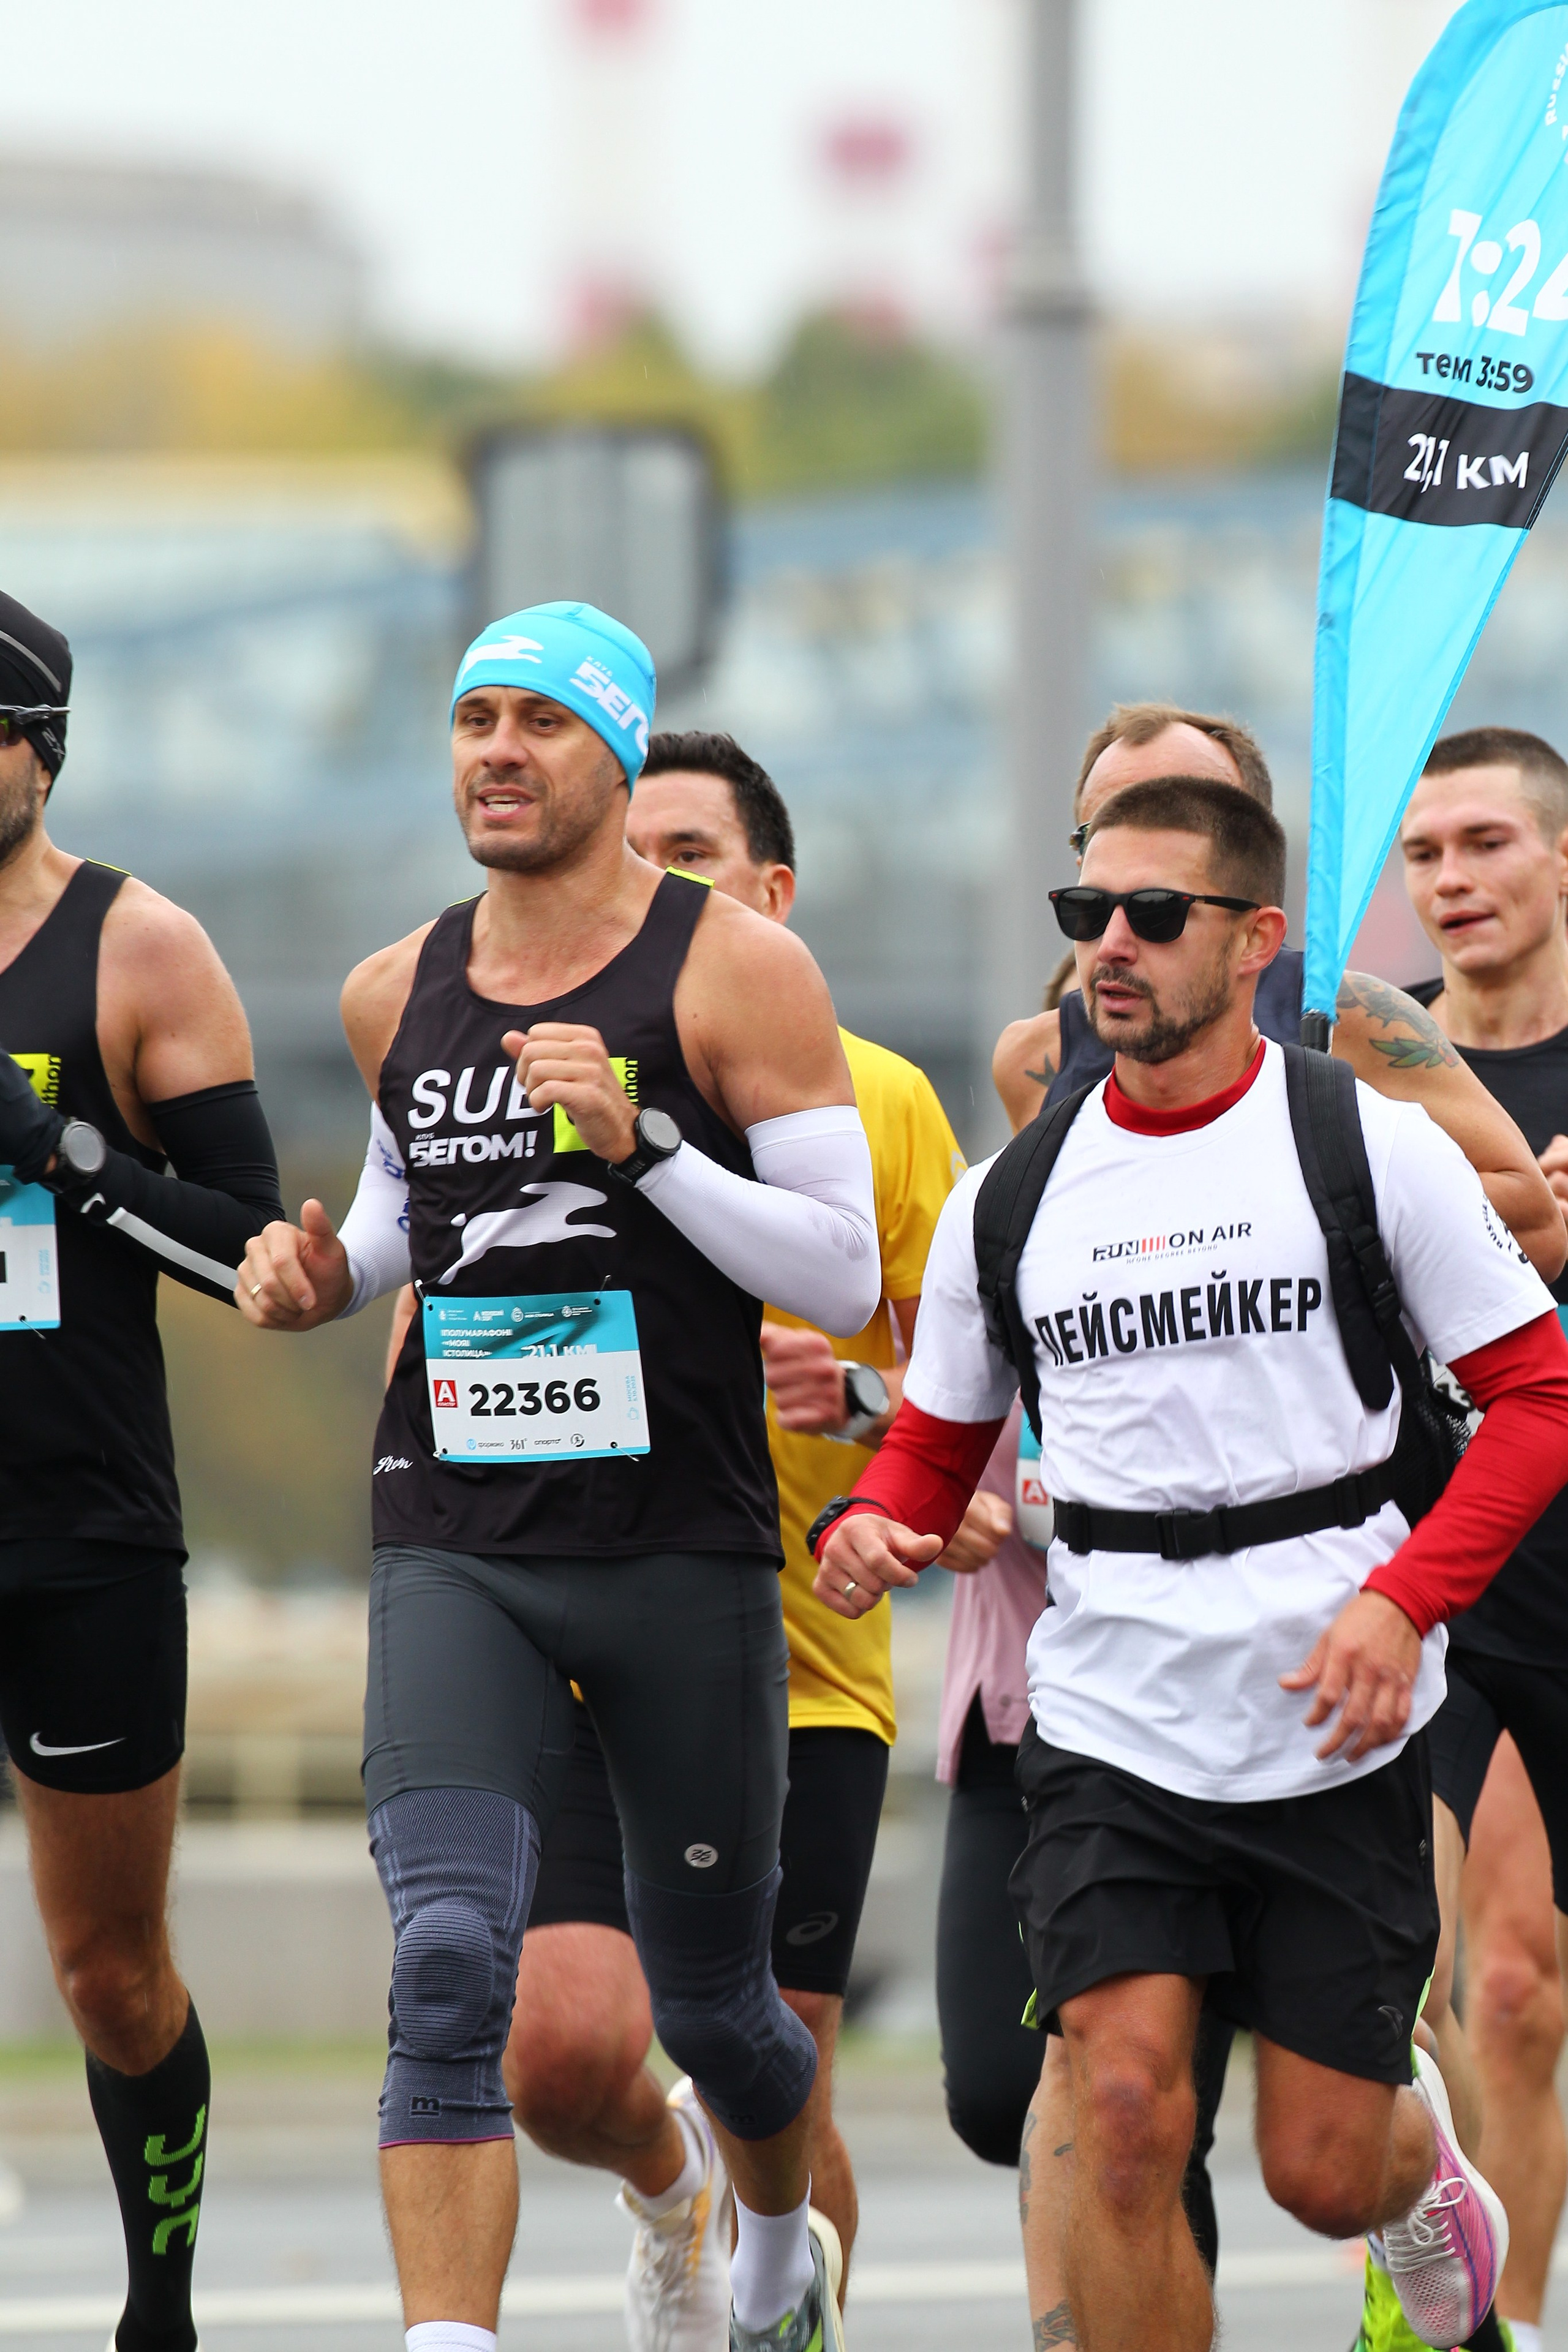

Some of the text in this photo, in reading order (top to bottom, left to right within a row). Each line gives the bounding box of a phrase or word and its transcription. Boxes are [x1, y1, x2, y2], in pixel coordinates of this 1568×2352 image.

[1476, 355, 1534, 393] 3:59
[1403, 433, 1450, 493] 21,1
[409, 1131, 538, 1167] БЕГОМ!
[1093, 1222, 1252, 1262] RUN ON AIR
[1035, 1270, 1322, 1367] ПЕЙСМЕЙКЕР
[469, 1378, 600, 1417] 22366
